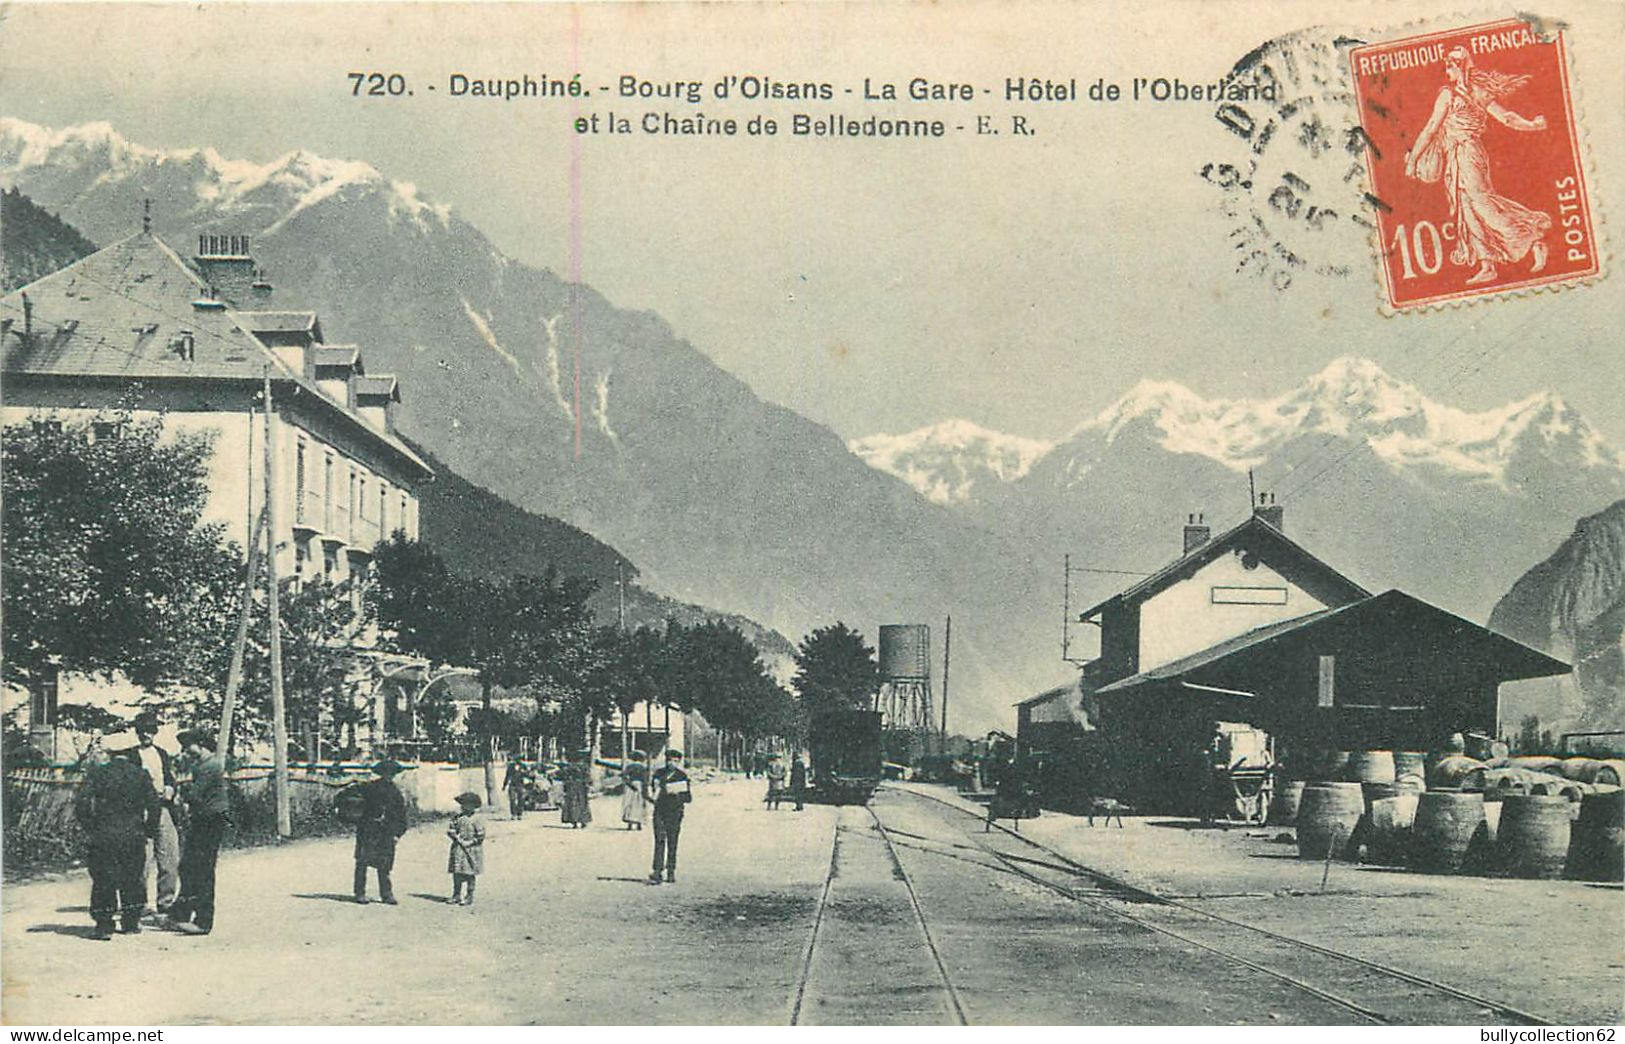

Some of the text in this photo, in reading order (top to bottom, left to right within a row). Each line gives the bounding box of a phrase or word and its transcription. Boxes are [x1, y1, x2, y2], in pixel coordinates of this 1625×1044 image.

[347, 72, 414, 97] 720.
[449, 73, 591, 101] Dauphiné.
[618, 75, 703, 103] Bourg
[713, 75, 834, 101] d'Oisans
[864, 77, 897, 101] La
[908, 77, 974, 101] Gare
[1005, 76, 1076, 102] Hôtel
[1088, 77, 1121, 102] de
[1133, 77, 1277, 102] l'Oberland
[574, 112, 600, 135] et
[608, 111, 633, 134] la
[641, 111, 738, 135] Chaîne
[746, 114, 778, 135] de
[792, 113, 945, 137] Belledonne
[977, 115, 999, 135] E.
[1011, 115, 1036, 136] R.
[1555, 175, 1587, 262] POSTES
